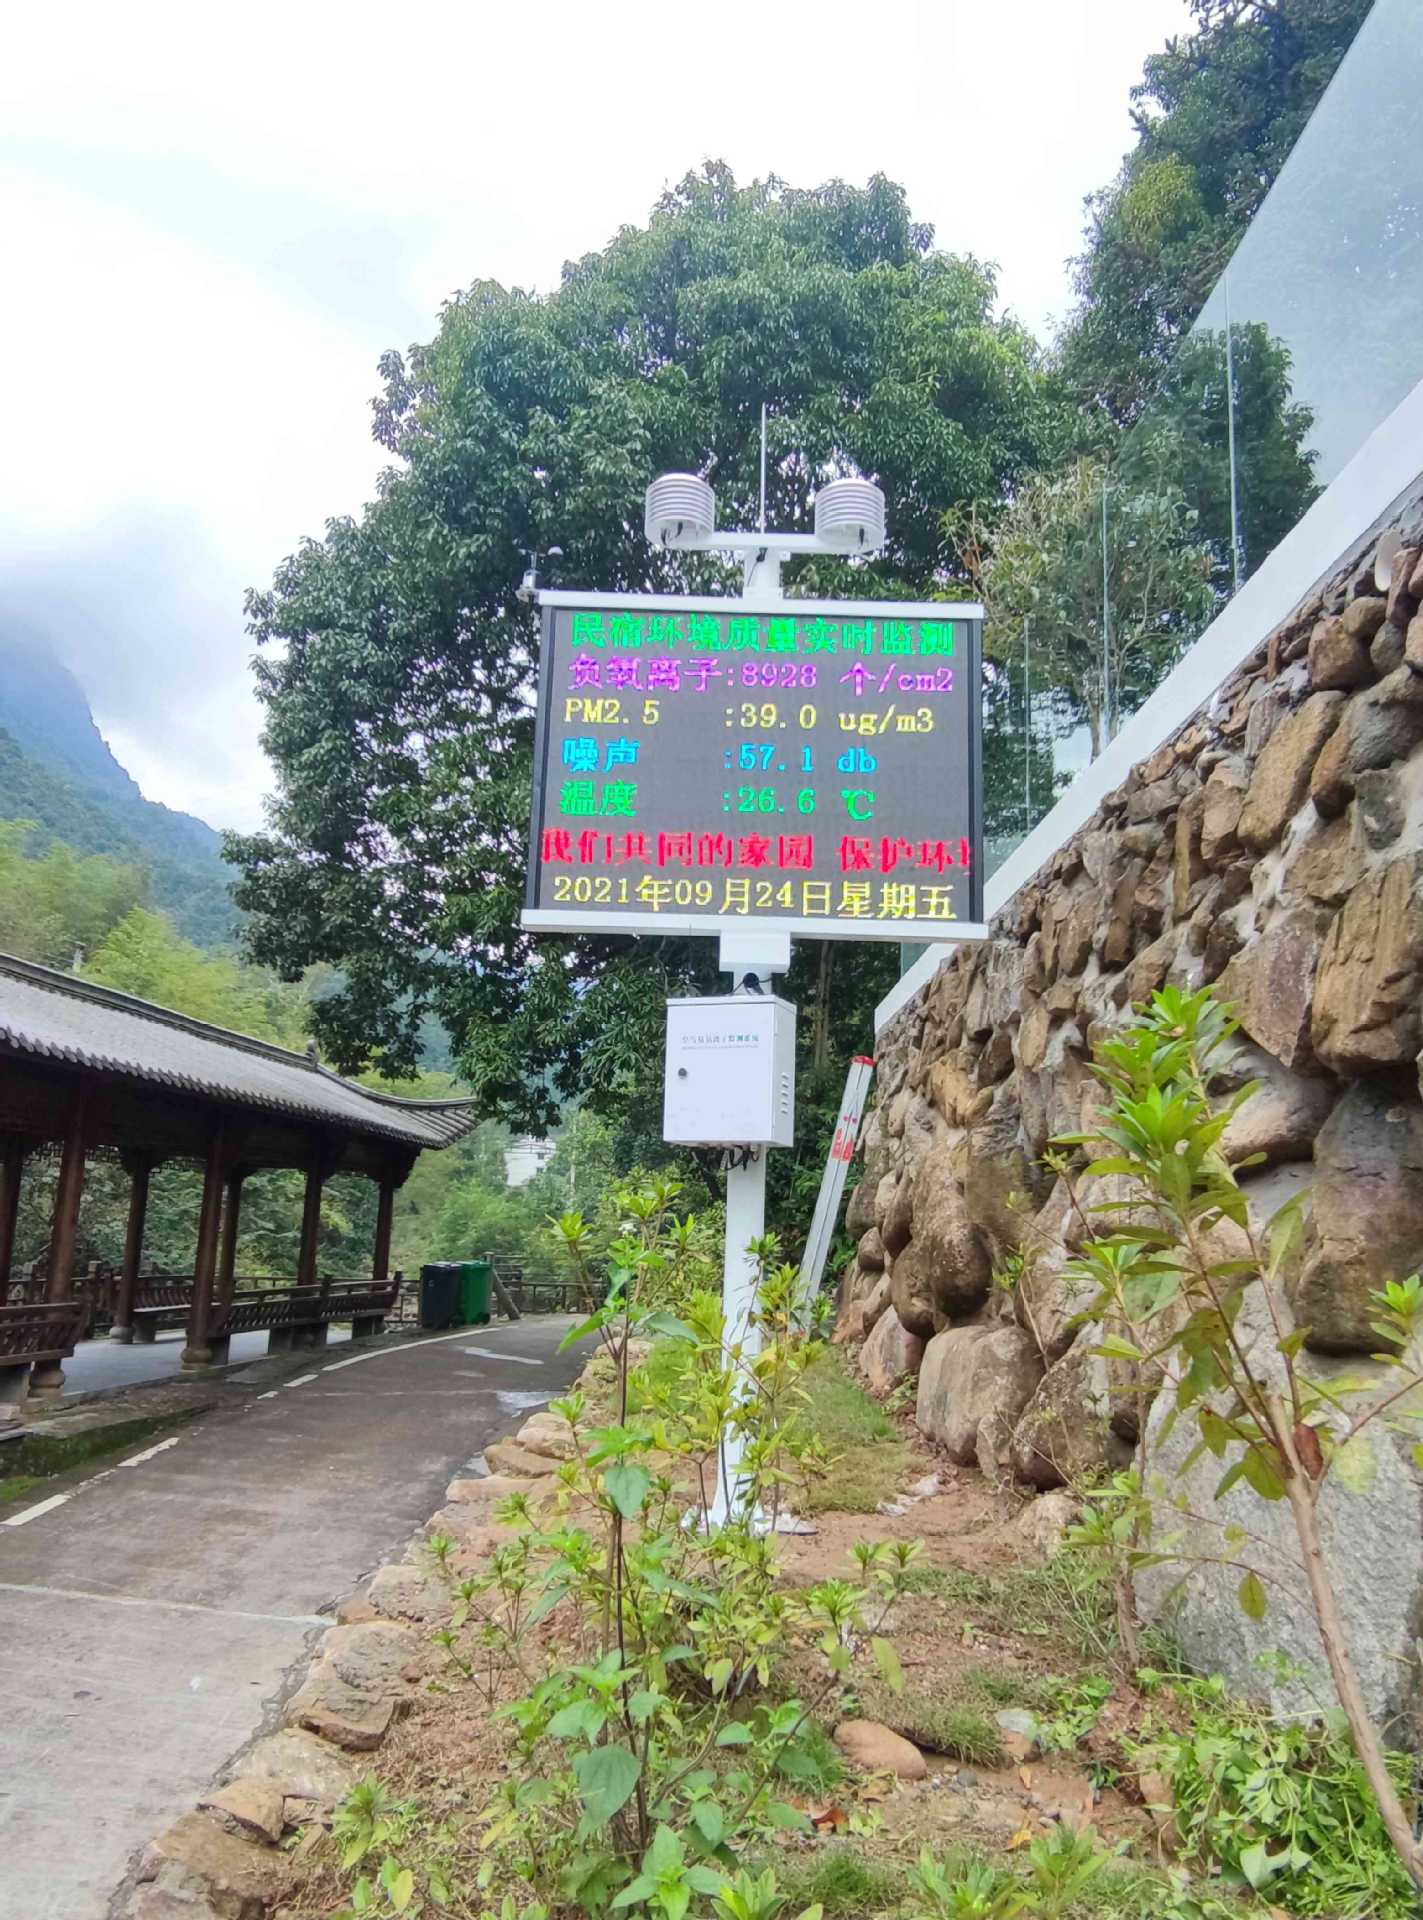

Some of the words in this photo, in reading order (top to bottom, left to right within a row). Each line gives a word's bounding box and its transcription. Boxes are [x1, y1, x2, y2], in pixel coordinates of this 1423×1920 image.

[572, 612, 954, 656] 民宿环境质量实时监测
[840, 661, 954, 696] 个/cm2
[838, 704, 935, 735] ug/m3
[562, 737, 641, 773] 噪声
[836, 747, 878, 773] db
[560, 781, 638, 817] 温度
[542, 828, 814, 869] 我们共同的家园
[553, 874, 957, 919] 2021年09月24日星期五
